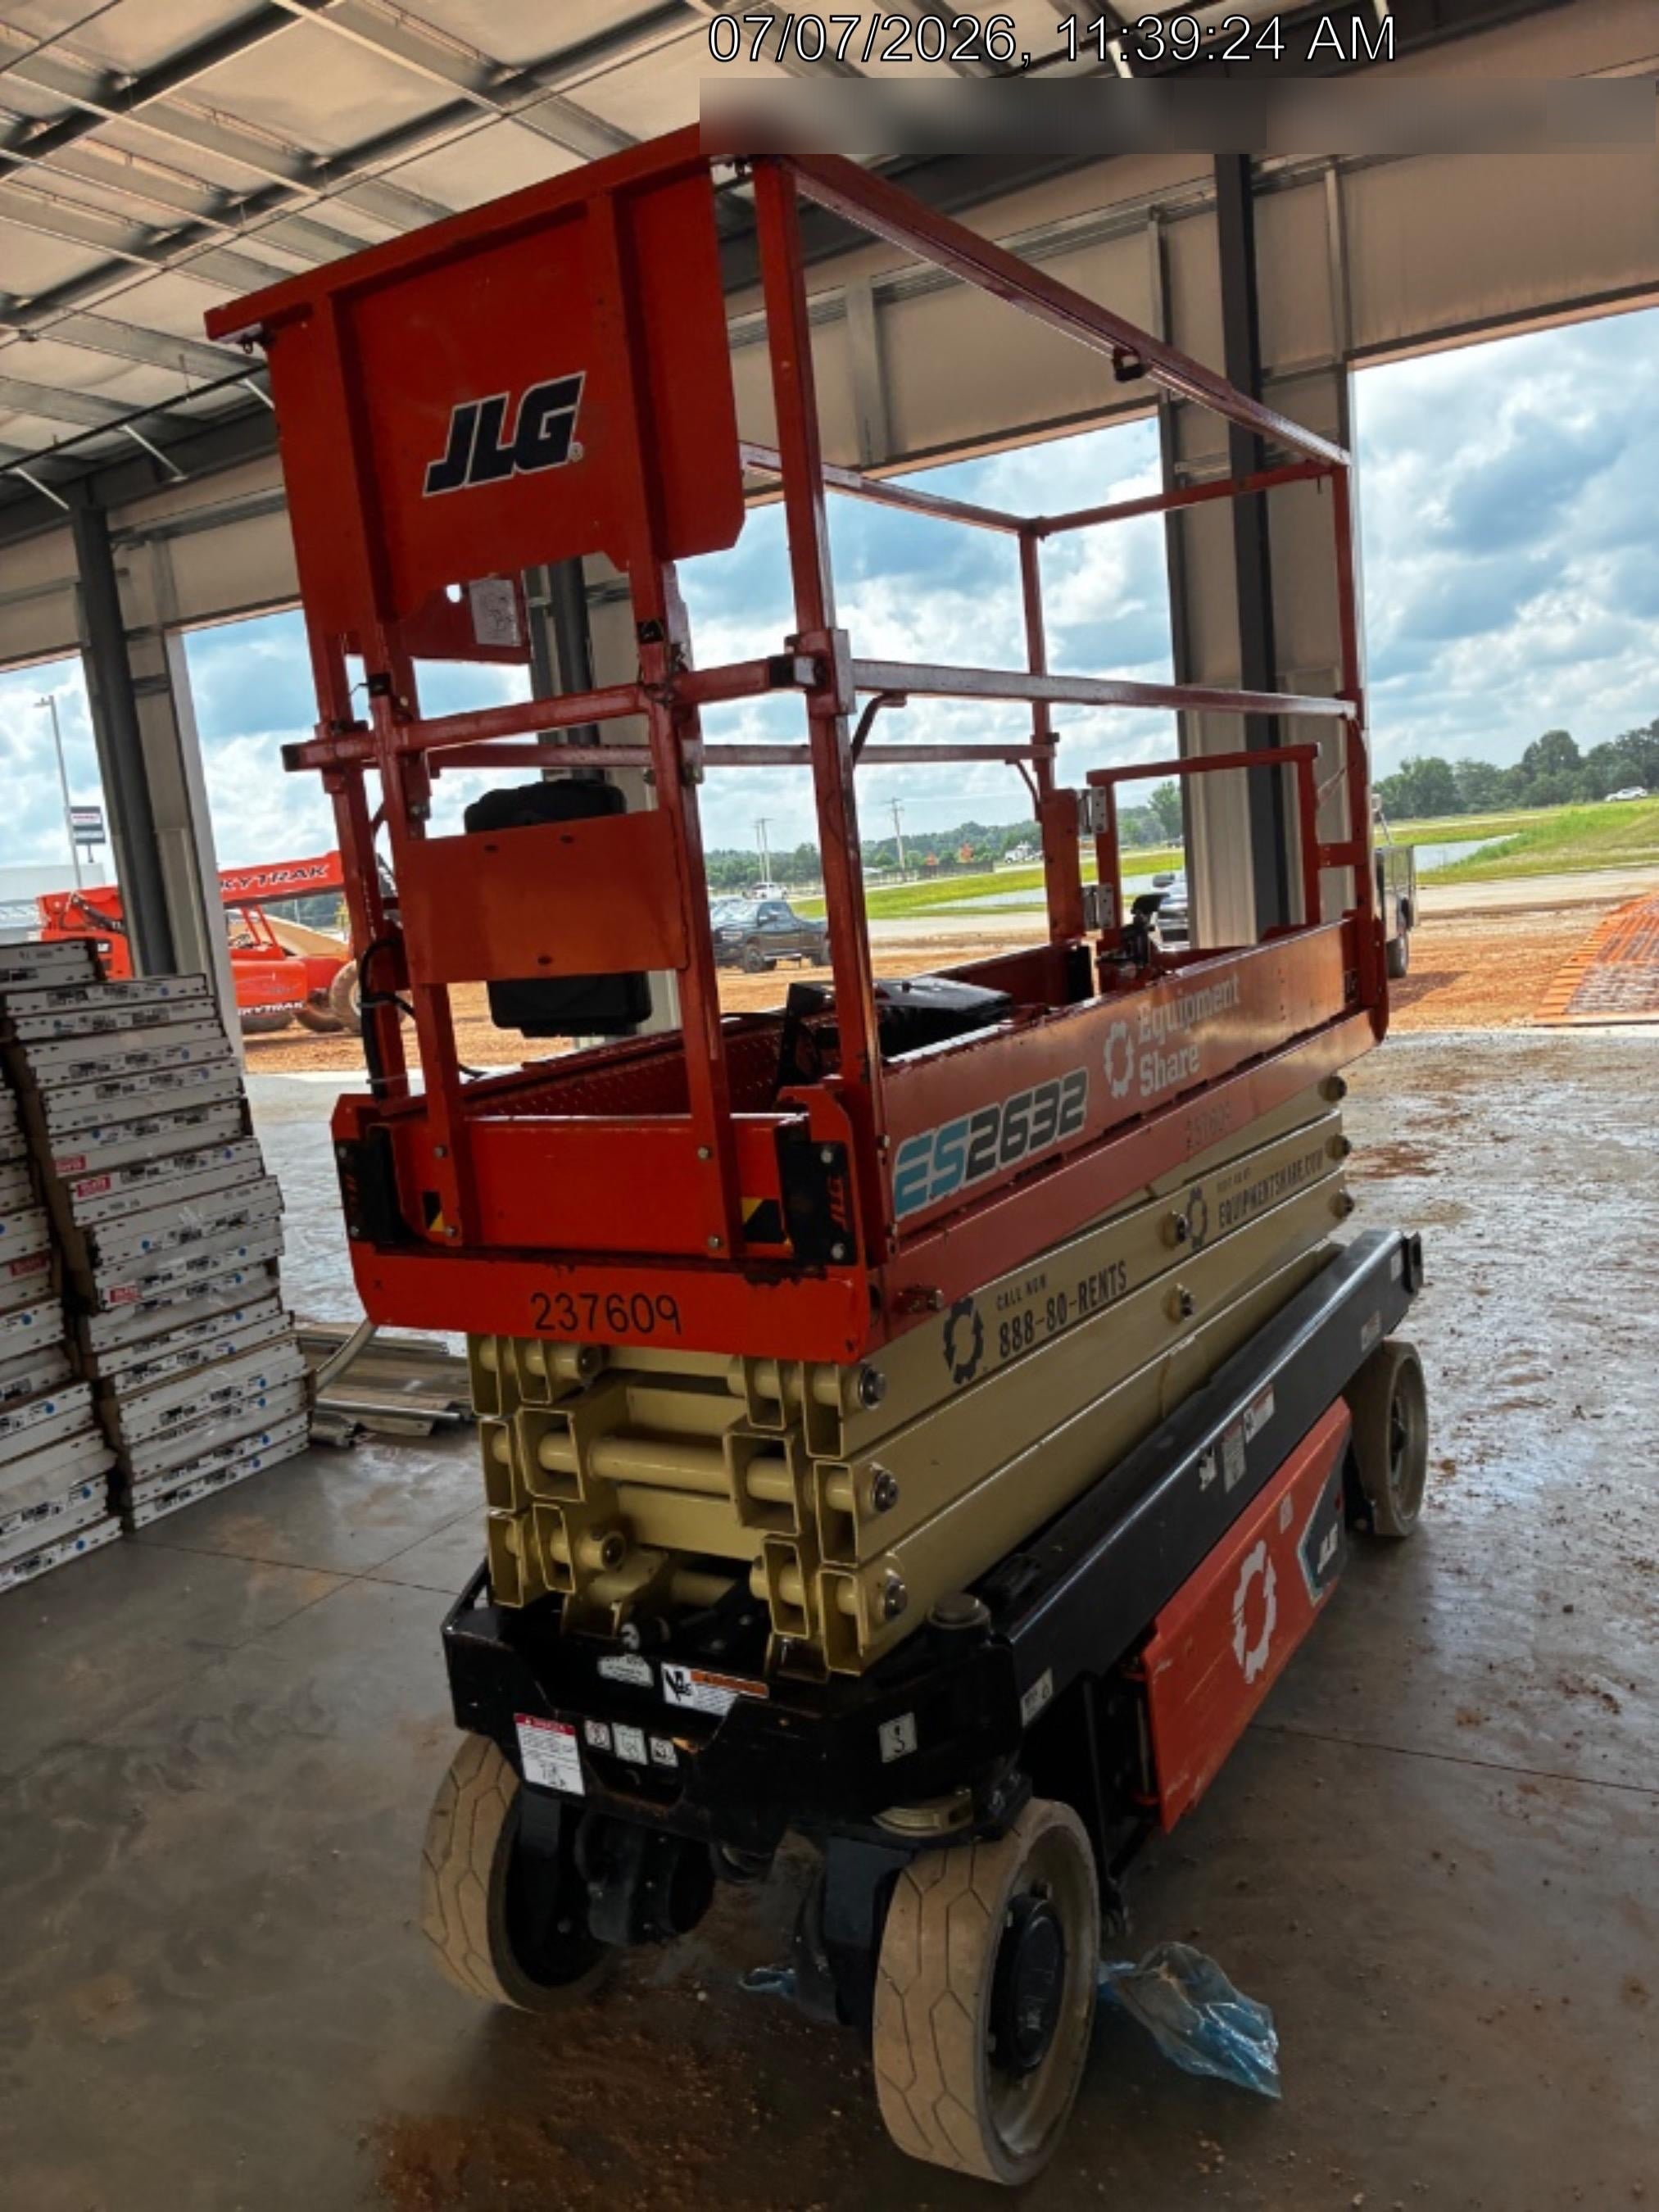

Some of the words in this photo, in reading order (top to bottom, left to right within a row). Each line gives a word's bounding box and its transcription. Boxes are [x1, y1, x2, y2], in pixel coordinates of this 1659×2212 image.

[422, 370, 587, 497] JLG
[220, 864, 329, 893] KYTRAK
[1139, 971, 1240, 1045] Equipment
[1140, 1043, 1201, 1098] Share
[892, 1067, 1089, 1221] ES2632
[531, 1292, 682, 1335] 237609
[996, 1287, 1022, 1311] CALL
[999, 1260, 1127, 1359] 888-80-RENTS
